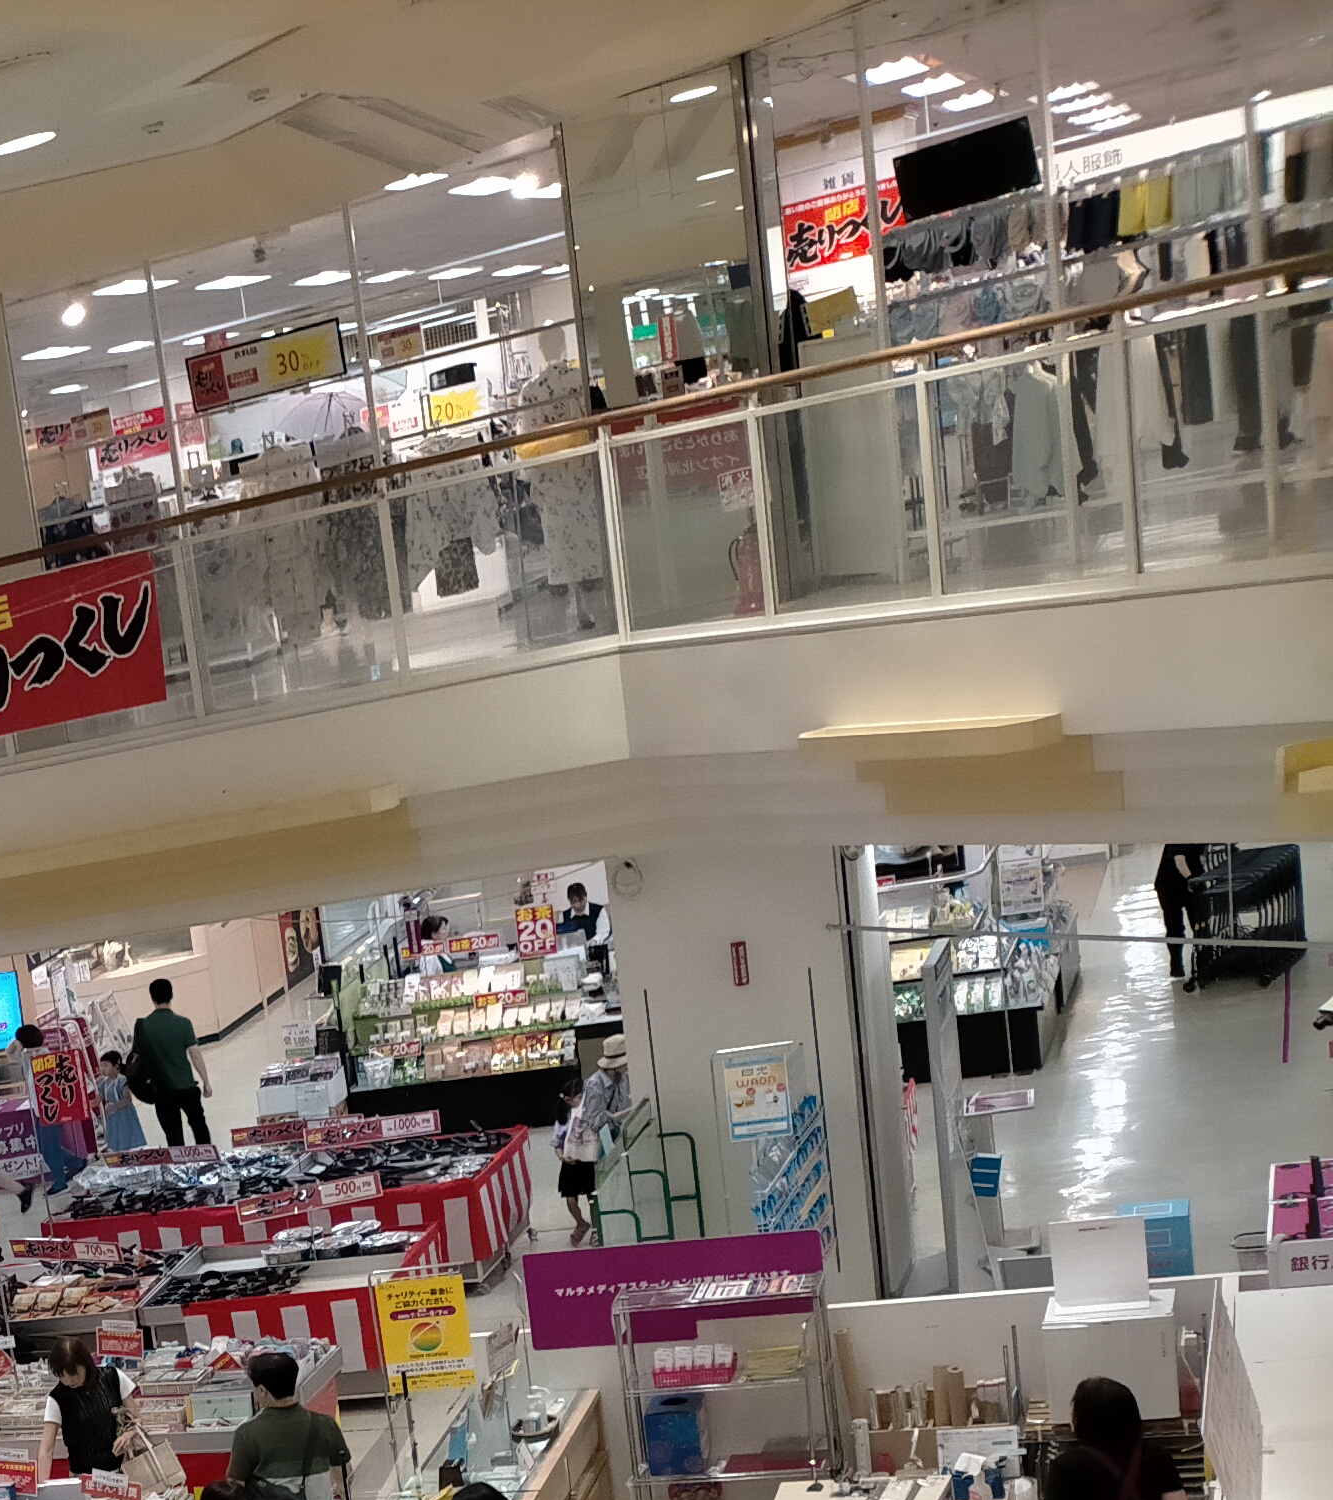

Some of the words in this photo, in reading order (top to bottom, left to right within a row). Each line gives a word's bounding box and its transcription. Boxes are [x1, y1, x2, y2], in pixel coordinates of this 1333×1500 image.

[1051, 147, 1124, 181] 人服飾
[518, 939, 556, 953] OFF
[1290, 1254, 1333, 1272] 銀行
